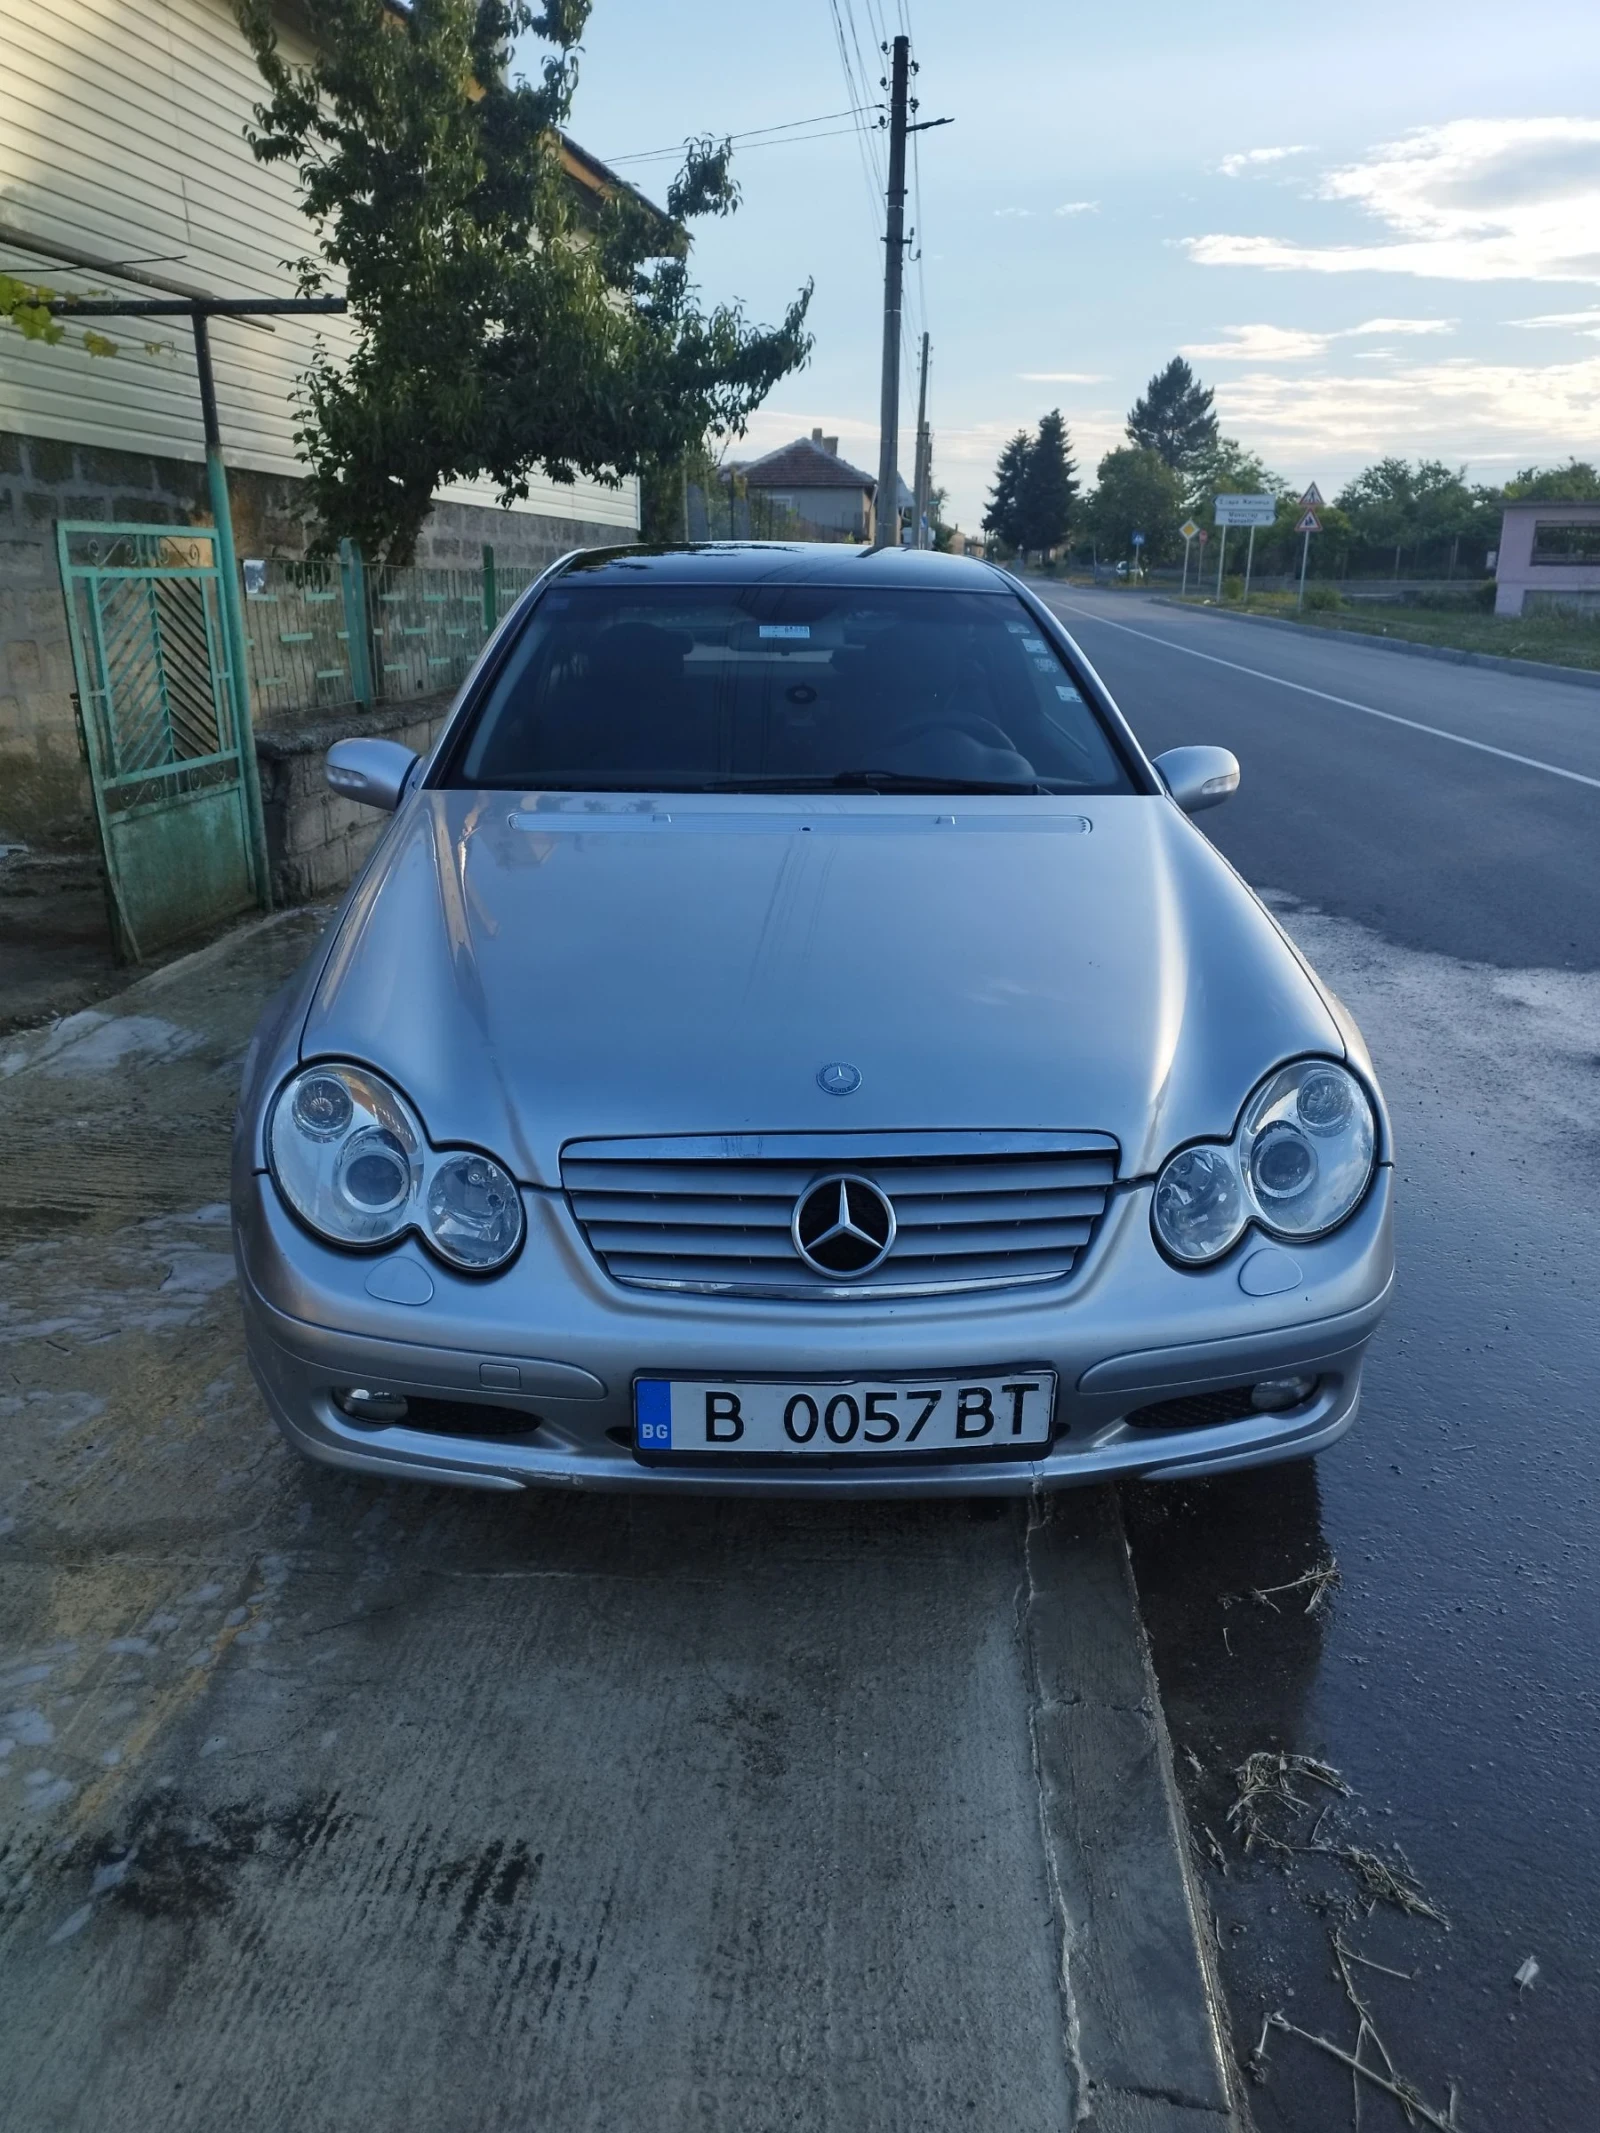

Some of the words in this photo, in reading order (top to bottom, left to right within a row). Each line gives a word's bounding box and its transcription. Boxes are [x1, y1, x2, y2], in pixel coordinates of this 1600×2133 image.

[642, 1424, 668, 1439] BG
[705, 1391, 745, 1443] B
[783, 1389, 942, 1444] 0057
